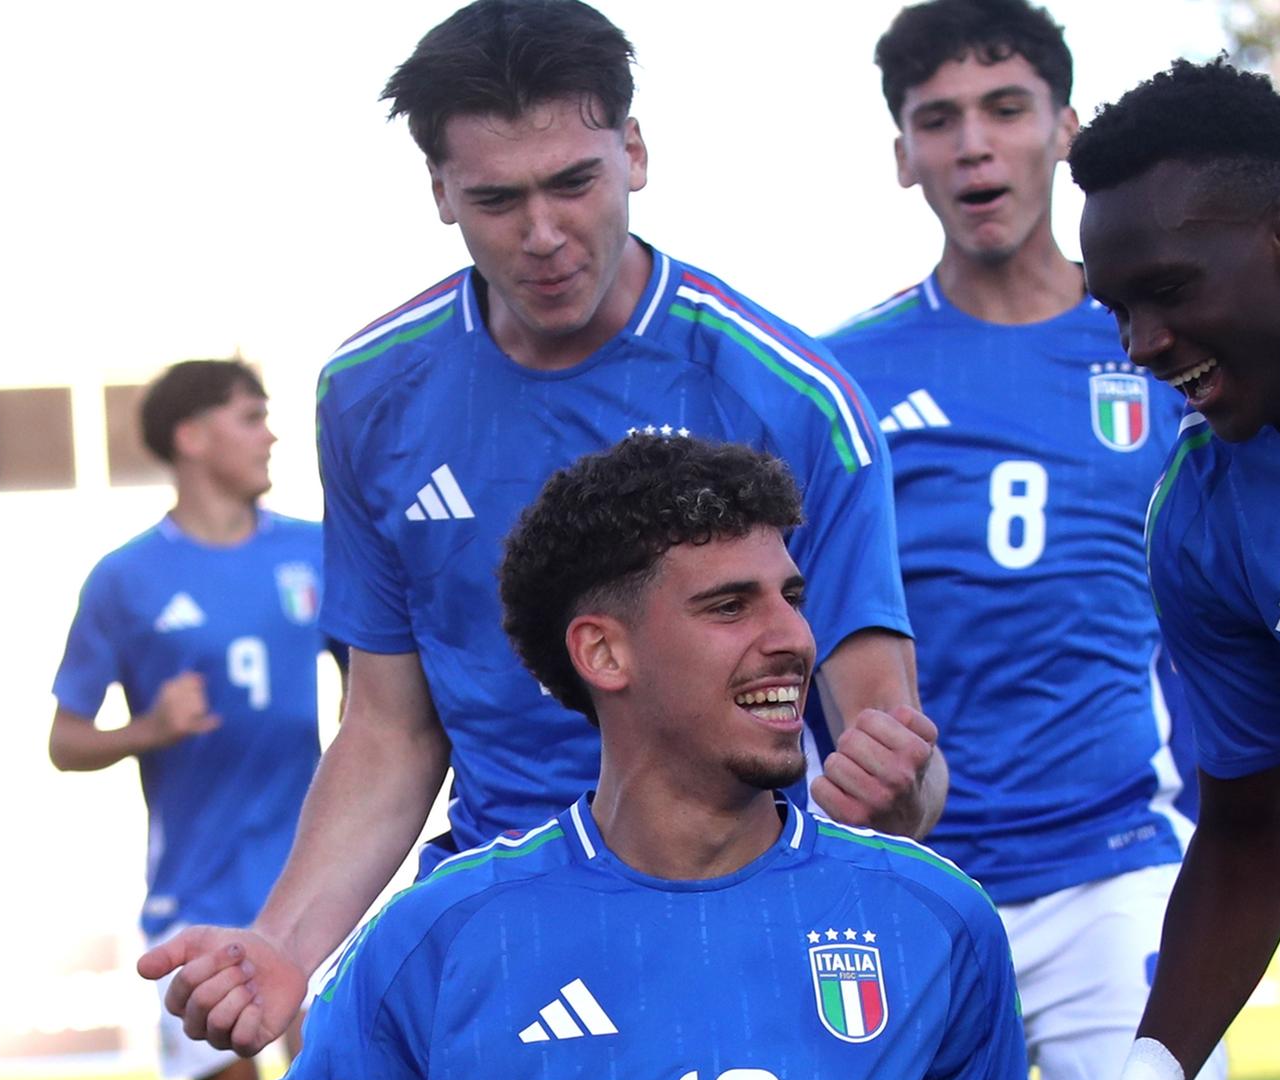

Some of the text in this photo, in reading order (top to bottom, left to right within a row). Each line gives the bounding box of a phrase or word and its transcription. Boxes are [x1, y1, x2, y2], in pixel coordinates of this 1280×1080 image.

[986, 460, 1049, 570] 8
[227, 636, 271, 711] 9
[815, 953, 876, 972] ITALIA
